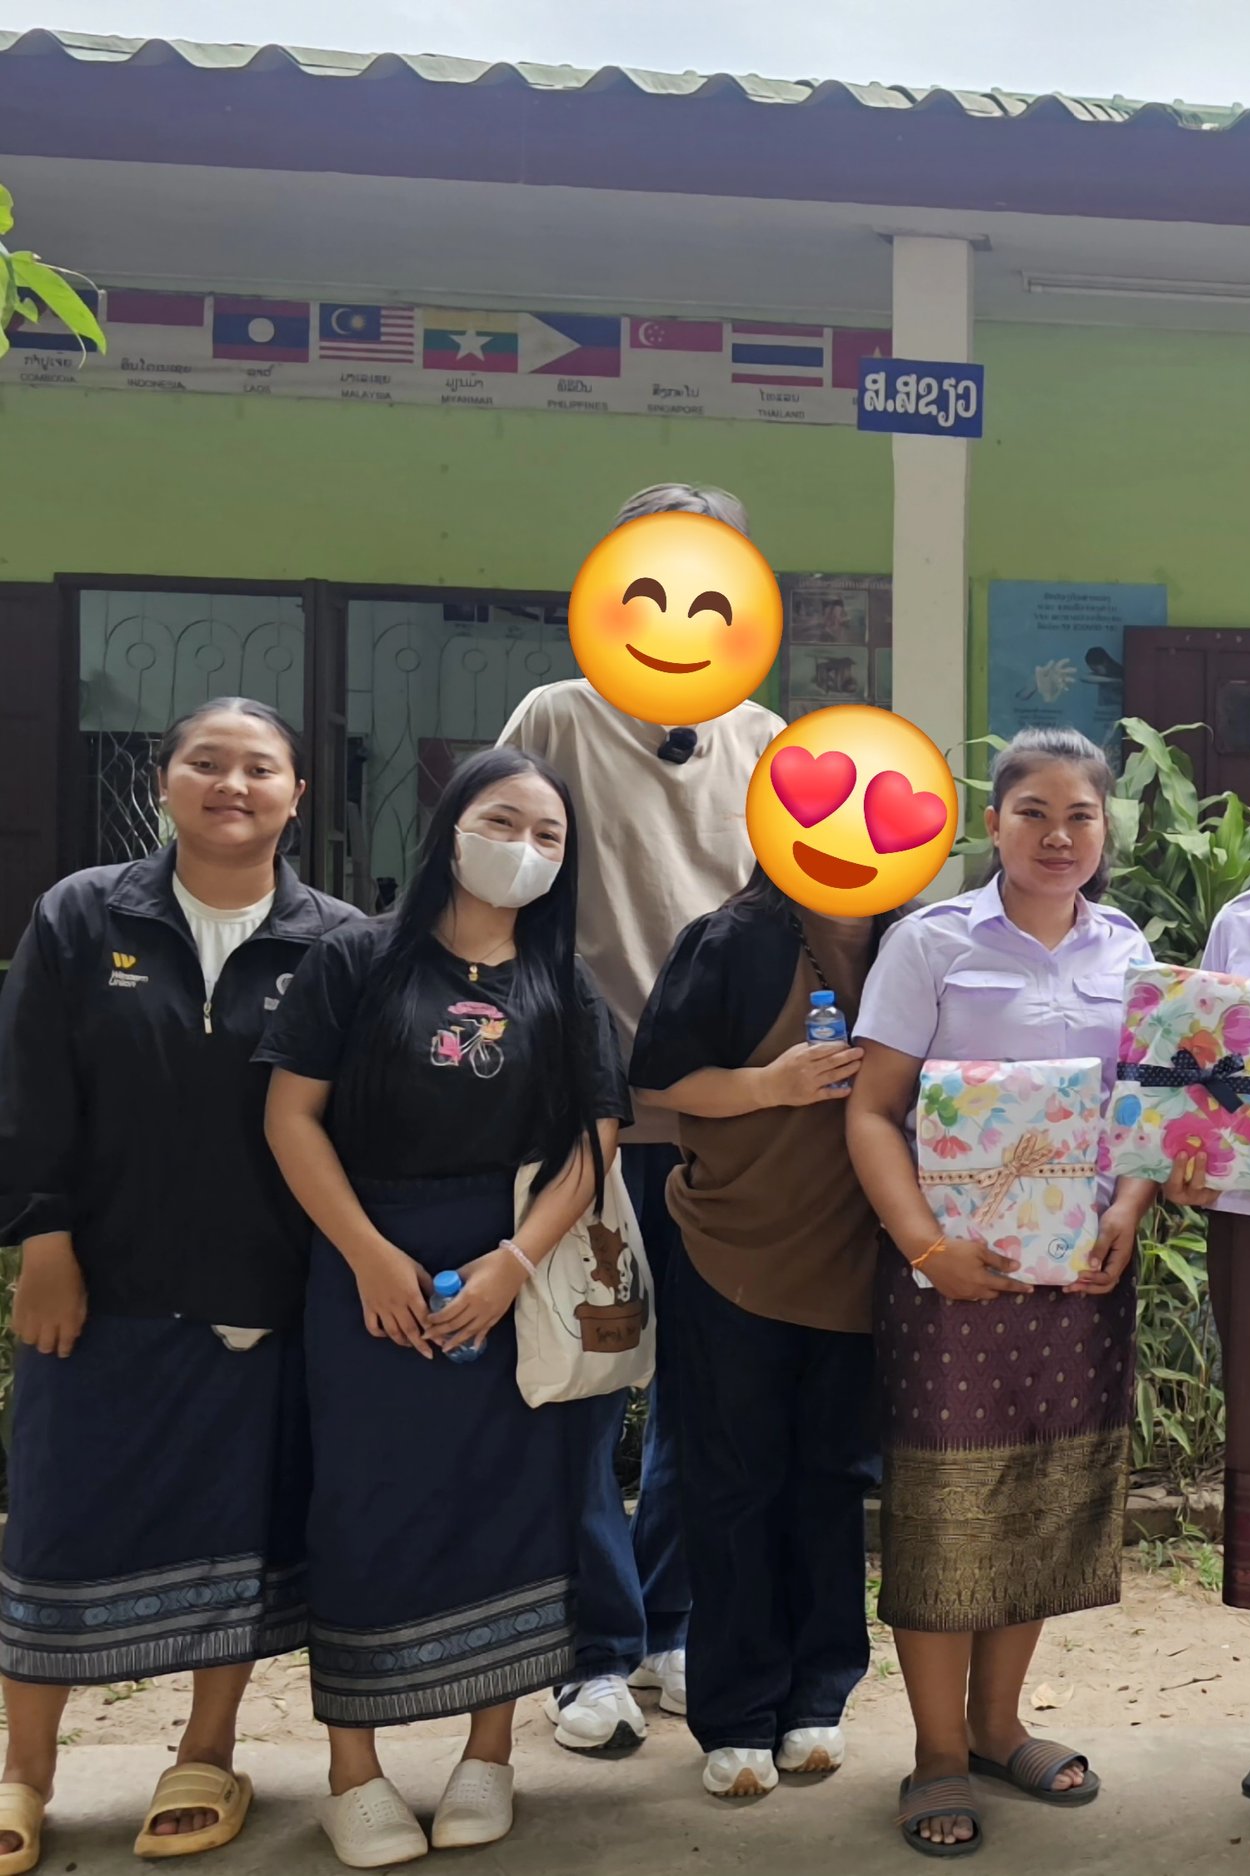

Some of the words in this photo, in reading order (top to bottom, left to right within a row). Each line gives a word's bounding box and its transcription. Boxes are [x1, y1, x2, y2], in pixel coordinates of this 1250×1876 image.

[127, 378, 187, 389] INDONESIA
[243, 384, 271, 394] LAOS
[341, 389, 392, 400] MALAYSIA
[441, 394, 493, 405] MYANMAR
[547, 399, 608, 411] PHILIPPINES
[647, 404, 703, 415] SINGAPORE
[758, 408, 806, 419] THAILAND
